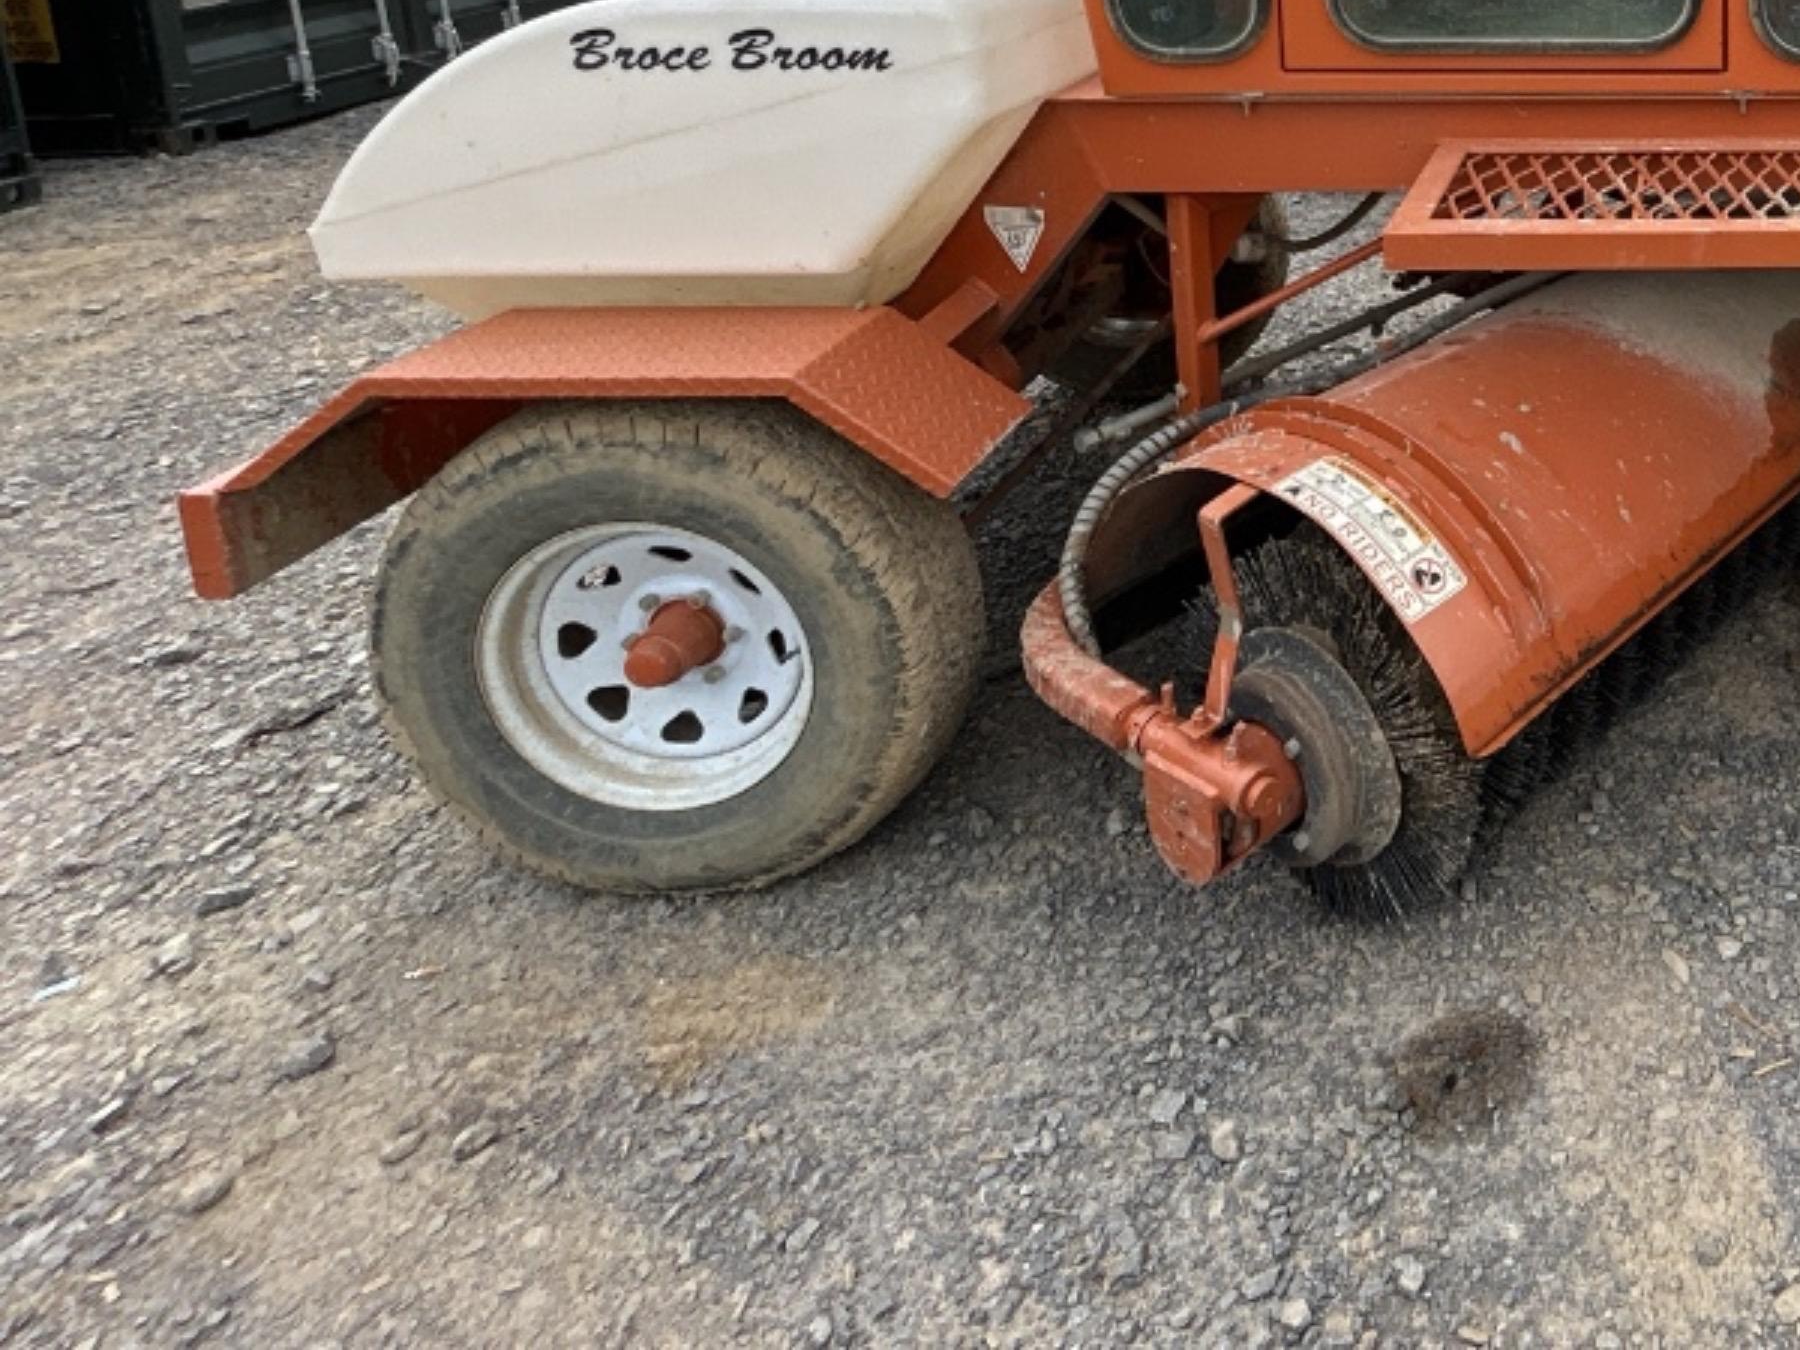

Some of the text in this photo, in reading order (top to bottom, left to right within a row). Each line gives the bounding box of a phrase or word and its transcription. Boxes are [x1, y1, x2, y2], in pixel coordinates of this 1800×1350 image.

[569, 28, 894, 71] Broce Broom
[1304, 493, 1416, 610] NO RIDERS
